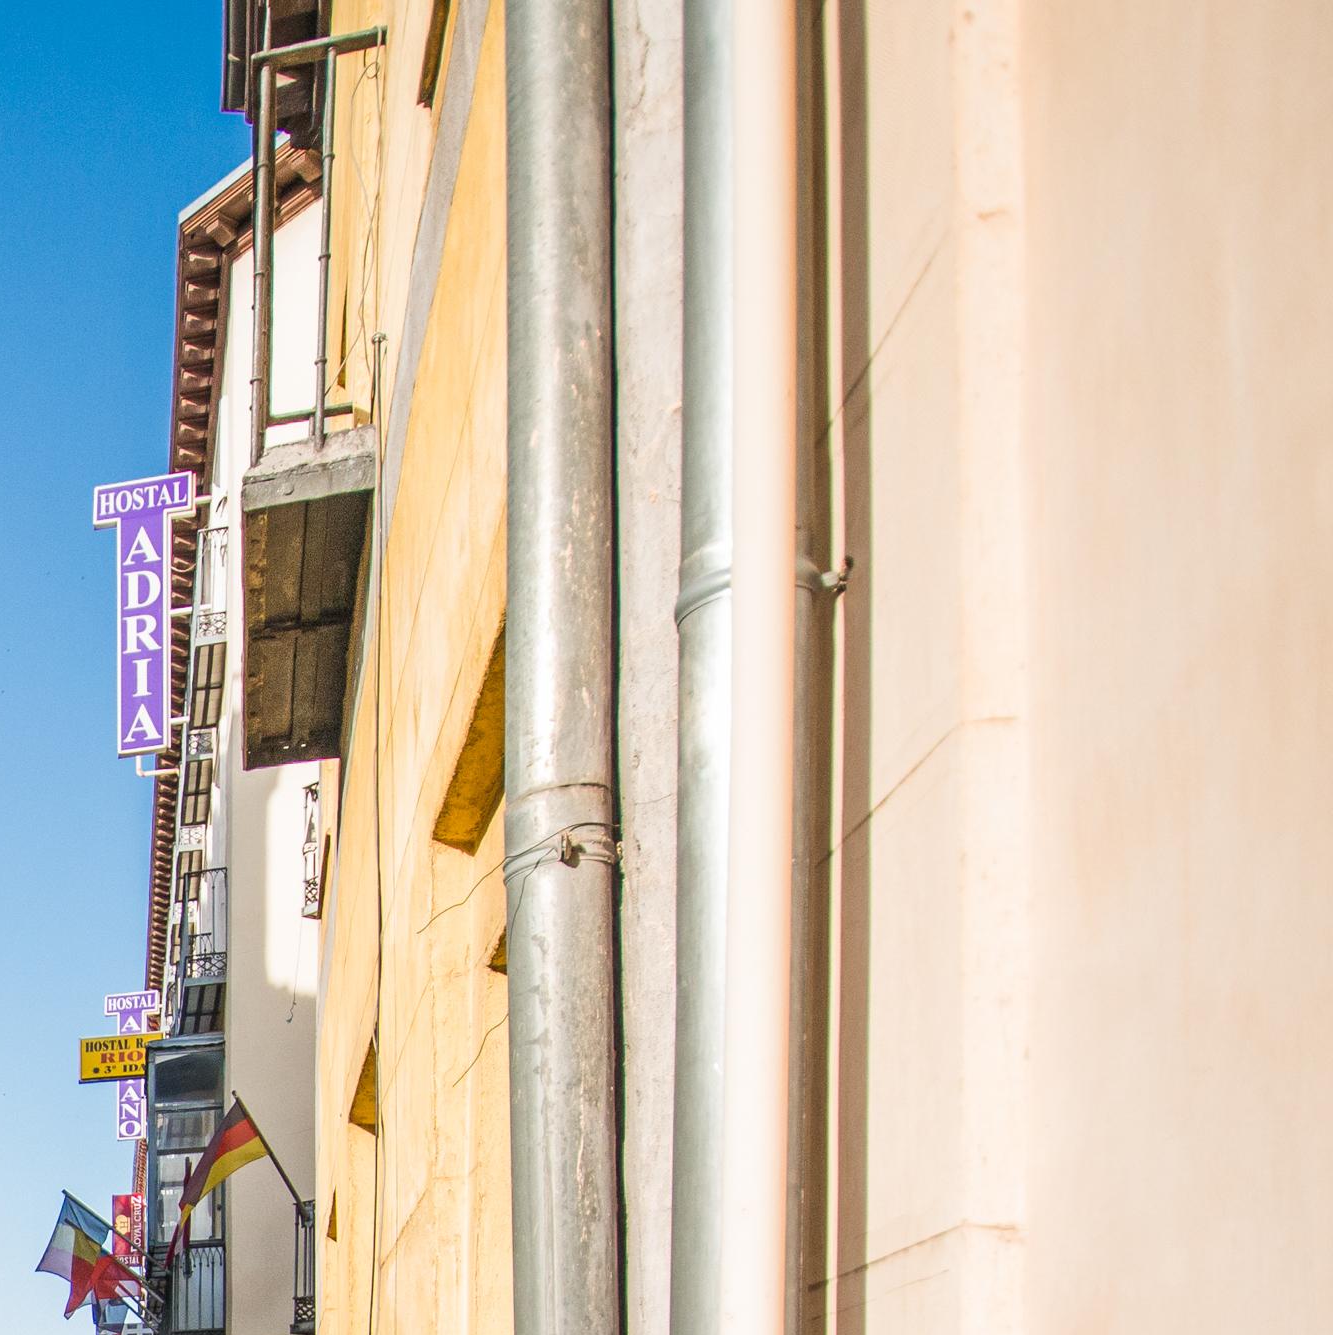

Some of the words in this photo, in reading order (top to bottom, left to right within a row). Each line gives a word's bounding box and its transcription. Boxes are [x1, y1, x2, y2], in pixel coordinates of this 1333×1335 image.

[99, 481, 188, 517] HOSTAL
[122, 526, 162, 743] ADRIA
[108, 994, 156, 1012] HOSTAL
[85, 1039, 130, 1053] HOSTAL
[100, 1050, 144, 1064] RIO
[130, 1195, 142, 1221] CRUZ
